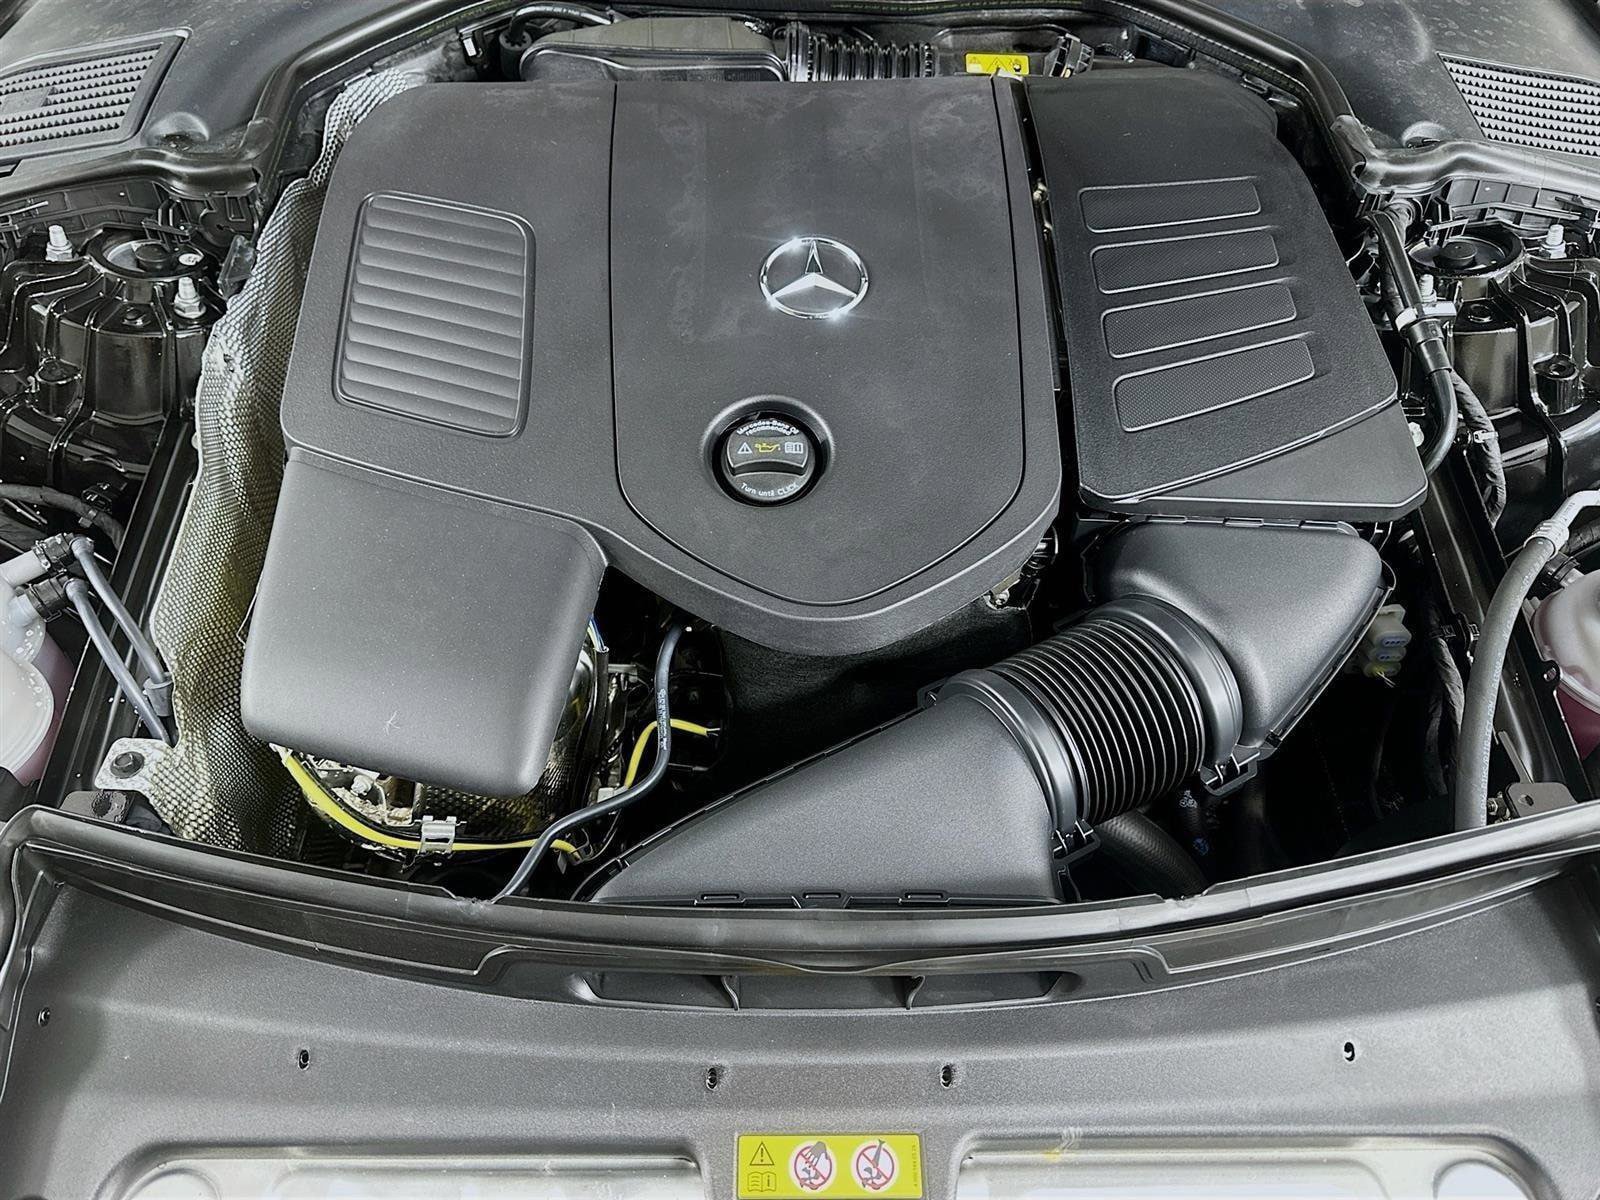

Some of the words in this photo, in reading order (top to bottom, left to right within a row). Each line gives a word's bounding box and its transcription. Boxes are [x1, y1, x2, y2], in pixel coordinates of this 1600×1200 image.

[746, 426, 791, 436] recommended
[741, 482, 756, 494] Turn
[777, 482, 799, 495] CLICK
